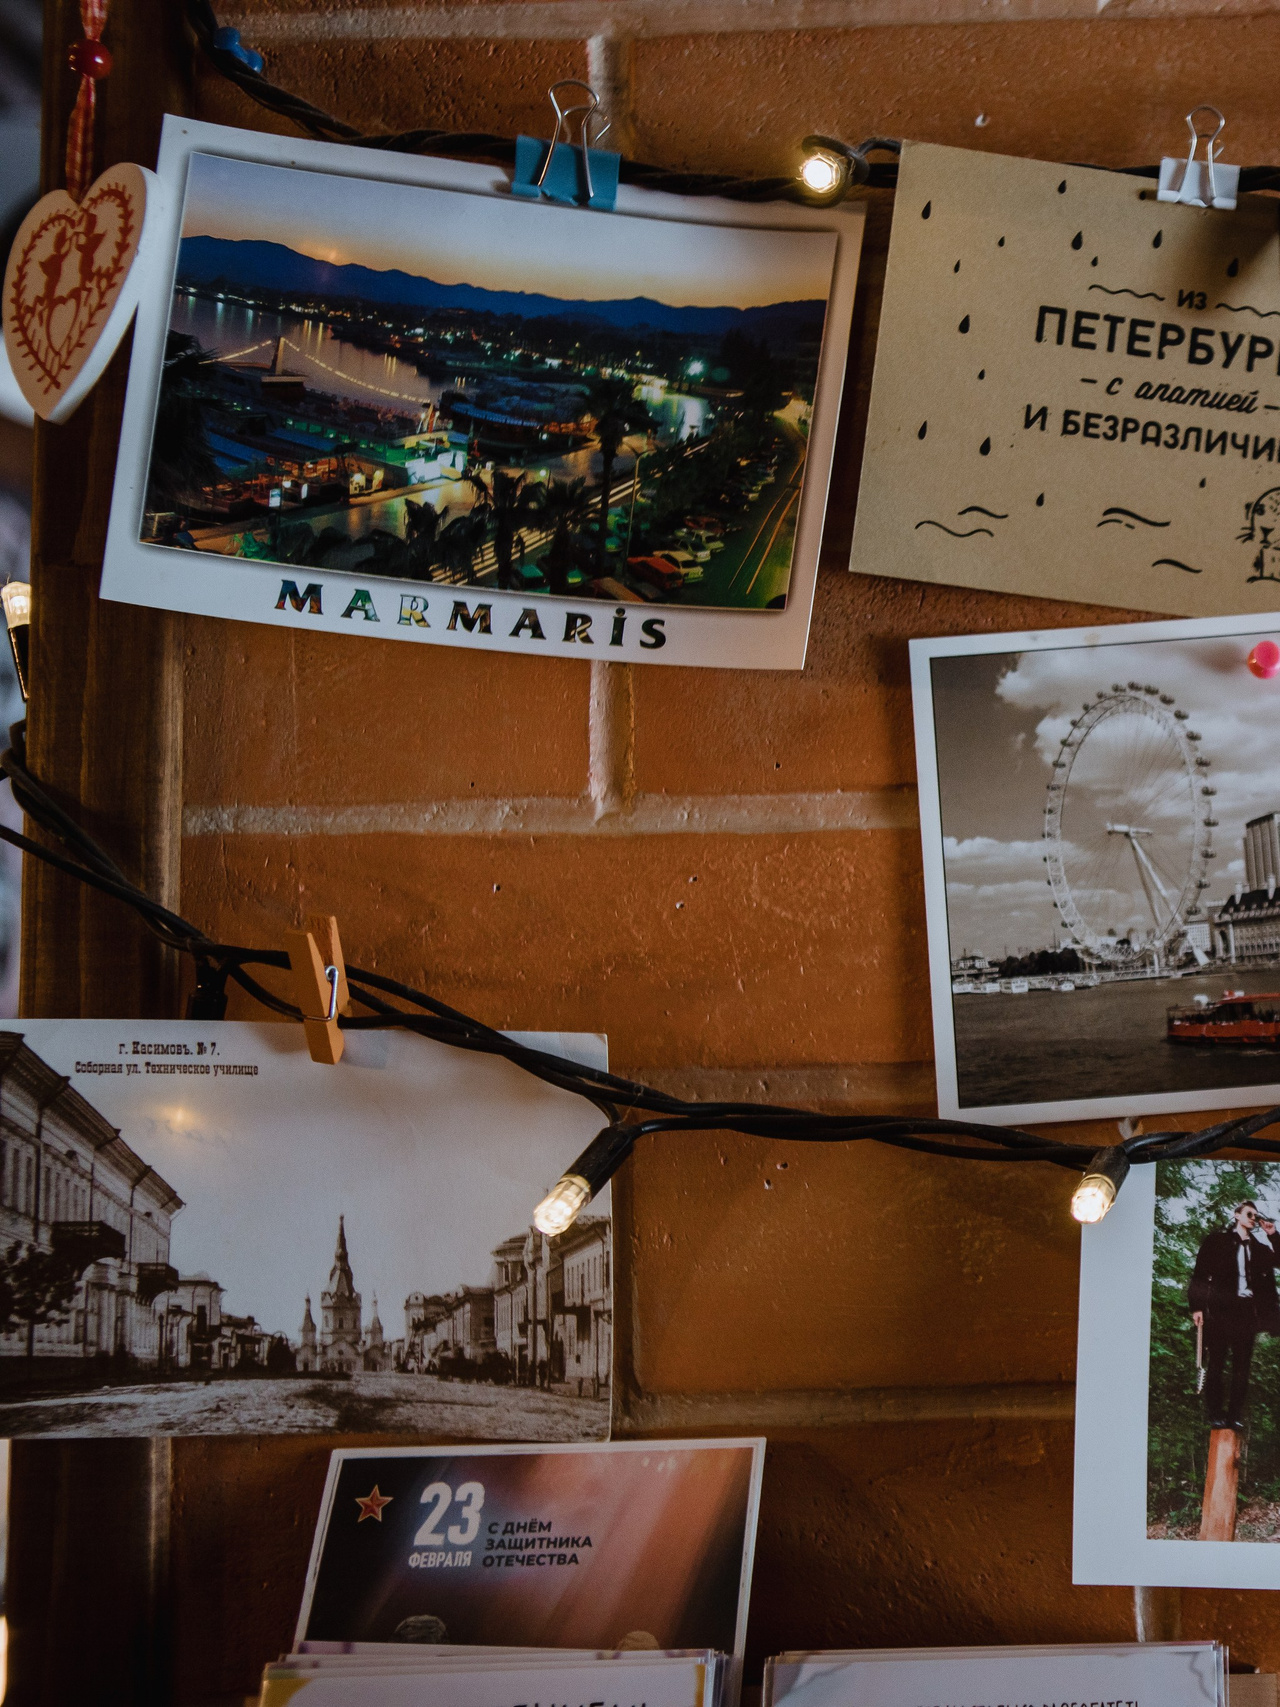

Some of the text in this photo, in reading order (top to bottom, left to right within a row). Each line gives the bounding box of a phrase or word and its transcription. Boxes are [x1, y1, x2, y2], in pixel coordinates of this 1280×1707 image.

[1177, 289, 1207, 310] ИЗ
[1105, 377, 1124, 395] с
[1135, 381, 1259, 414] апатией
[1024, 403, 1048, 431] И
[118, 1043, 129, 1055] г.
[75, 1061, 259, 1077] Соборная ул. Техническое училище
[413, 1481, 486, 1546] 23
[488, 1518, 552, 1535] С ДНЁМ
[485, 1536, 593, 1552] ЗАЩИТНИКА
[408, 1551, 473, 1569] ФЕВРАЛЯ
[482, 1553, 580, 1568] ОТЕЧЕСТВА
